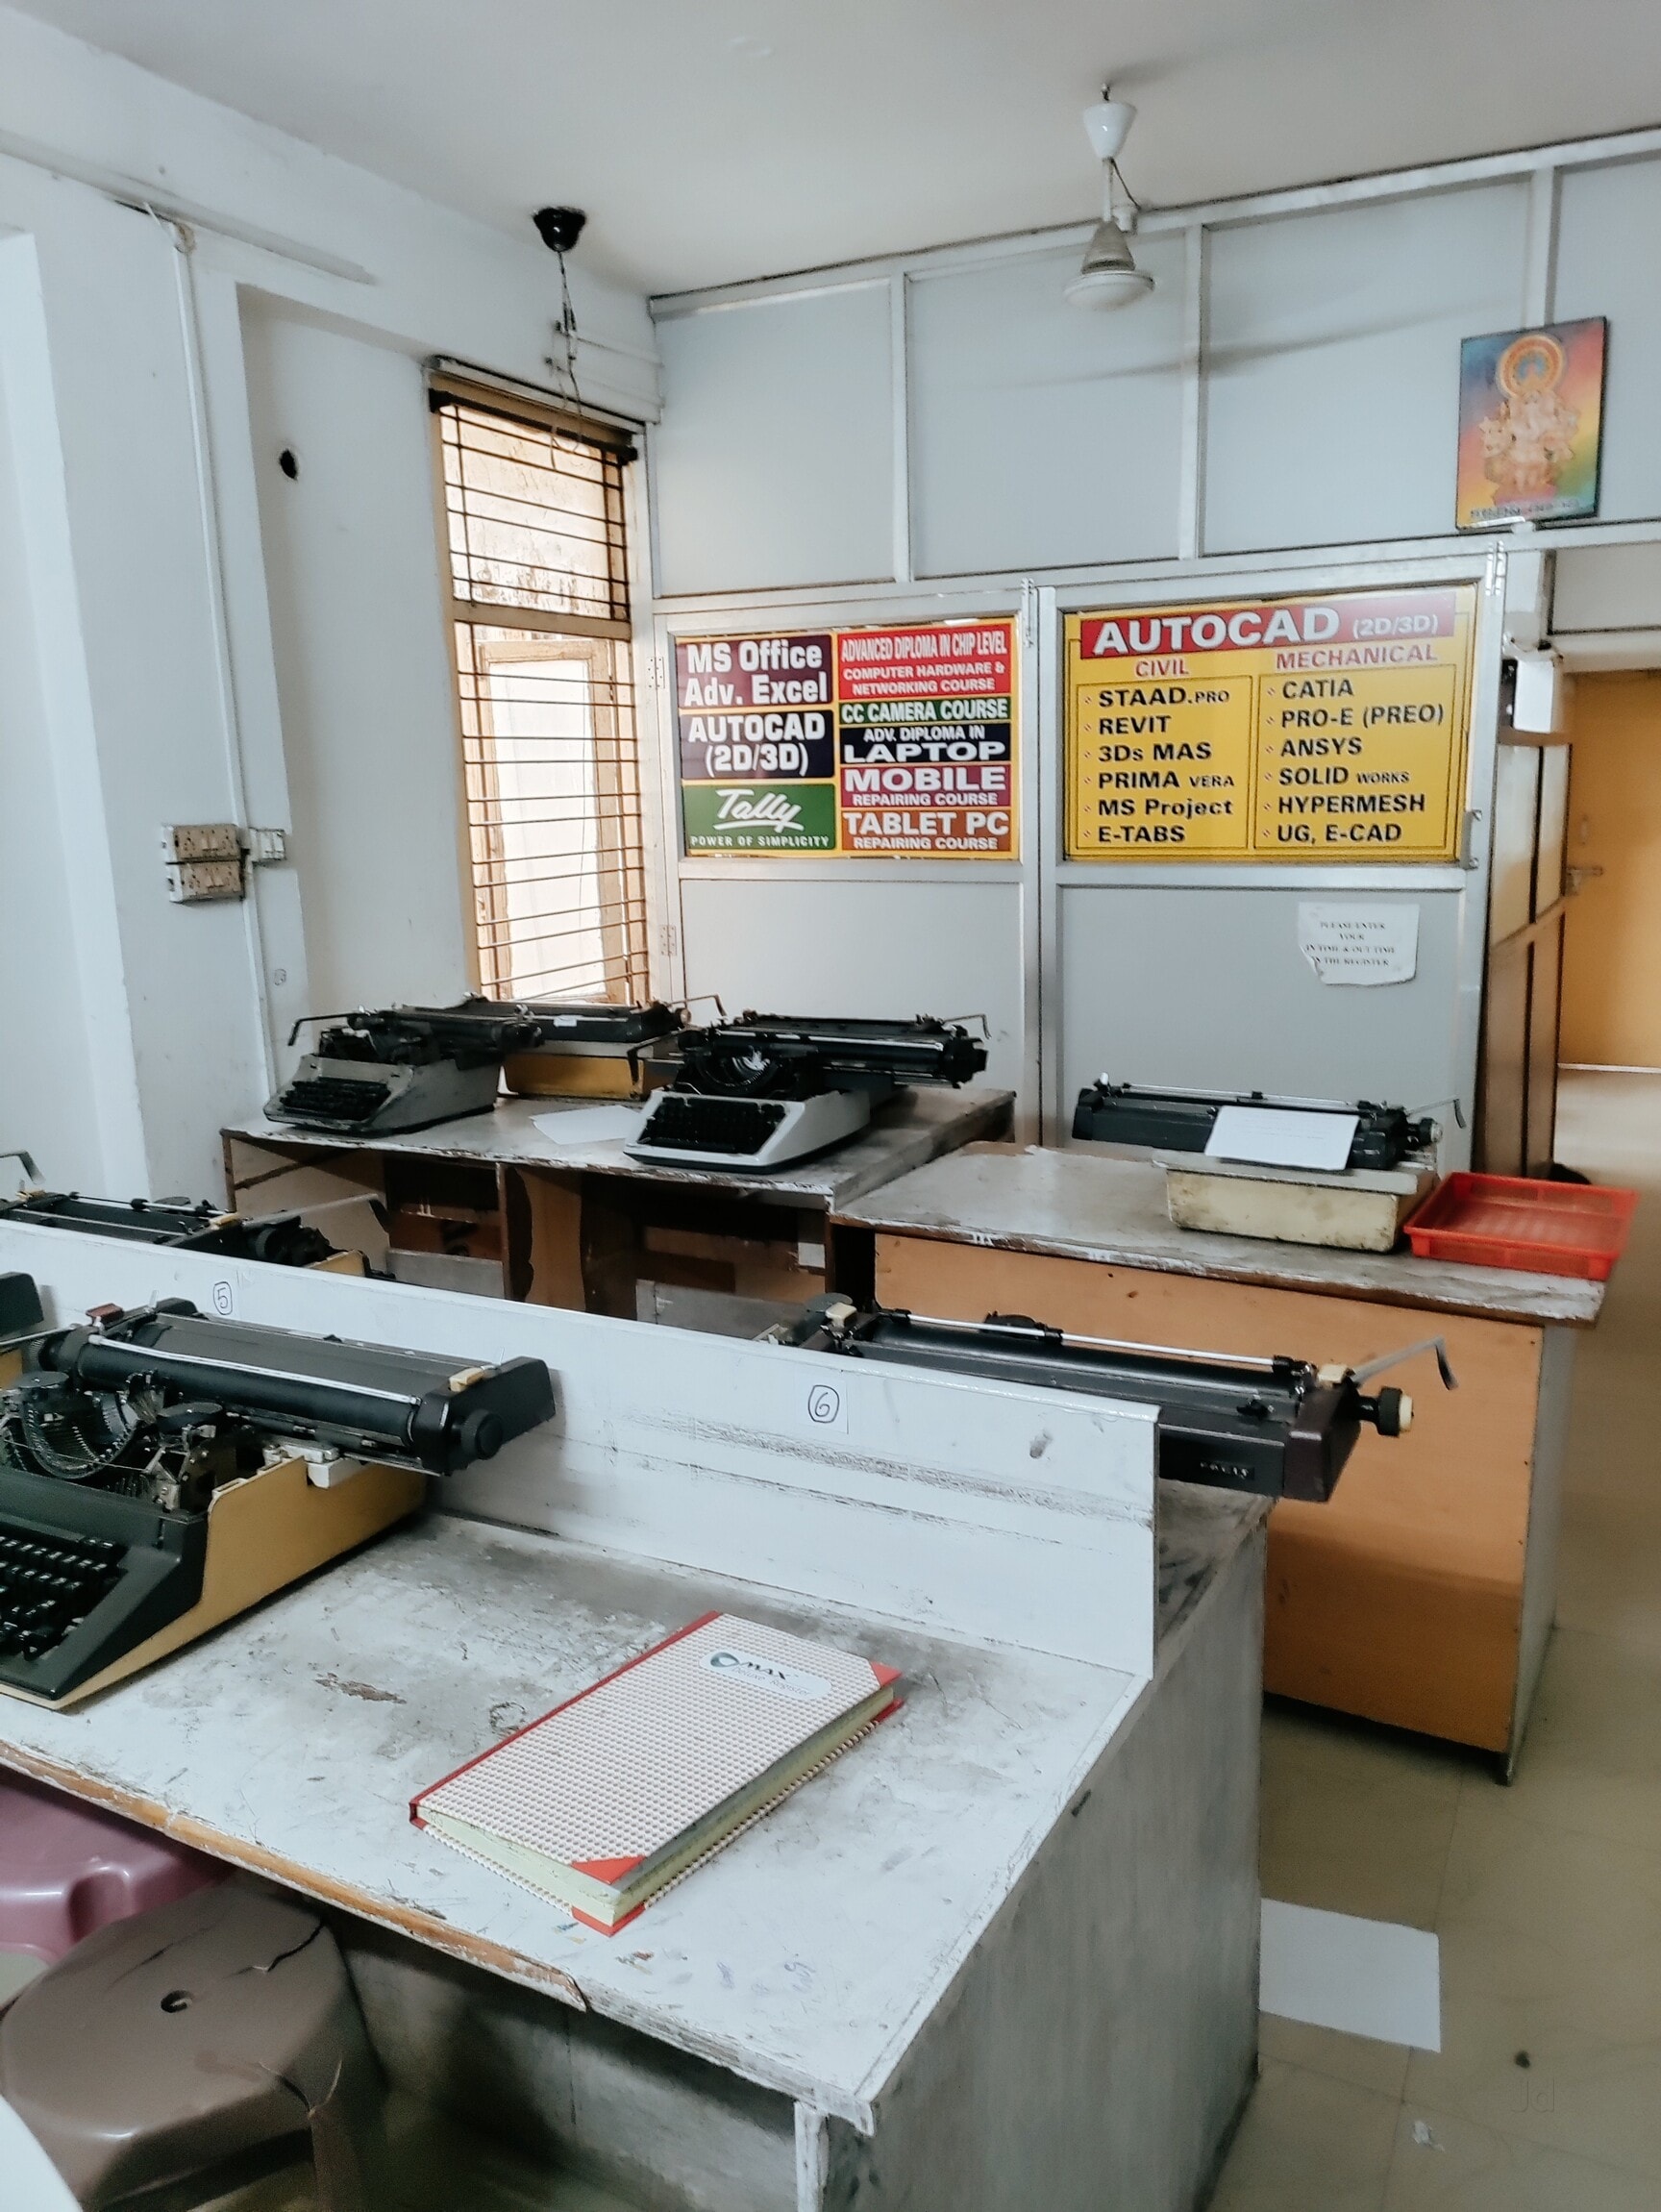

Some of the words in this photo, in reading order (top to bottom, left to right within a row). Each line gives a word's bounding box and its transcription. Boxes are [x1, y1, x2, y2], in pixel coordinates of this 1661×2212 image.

[1092, 607, 1340, 656] AUTOCAD
[1353, 614, 1438, 638] (2D/3D)
[685, 641, 732, 674] MS
[738, 638, 823, 672] Office
[841, 636, 893, 662] ADVANCED
[894, 634, 938, 659] DIPLOMA
[939, 633, 952, 658] IN
[952, 632, 976, 657] CHIP
[977, 630, 1007, 656] LEVEL
[1277, 644, 1438, 669] MECHANICAL
[843, 665, 913, 681] COMPUTER
[916, 662, 992, 678] HARDWARE
[994, 661, 1005, 674] &
[1135, 659, 1189, 678] CIVIL
[683, 676, 743, 707] Adv.
[751, 671, 828, 705] Excel
[853, 681, 938, 696] NETWORKING
[940, 678, 995, 692] COURSE
[1282, 679, 1353, 699] CATIA
[841, 704, 864, 723] CC
[867, 701, 937, 722] CAMERA
[940, 698, 1008, 720] COURSE
[1282, 708, 1353, 729] PRO-E
[1363, 704, 1443, 729] (PREO)
[688, 712, 826, 743] AUTOCAD
[863, 728, 896, 742] ADV.
[900, 726, 966, 741] DIPLOMA
[969, 725, 985, 739] IN
[1100, 715, 1172, 734] REVIT
[844, 741, 1005, 763] LAPTOP
[1098, 744, 1144, 762] 3Ds
[1153, 742, 1211, 760] MAS
[1280, 736, 1362, 757] ANSYS
[706, 742, 809, 778] (2D/3D)
[844, 766, 1006, 792] MOBILE
[1099, 771, 1179, 789] PRIMA
[1189, 776, 1234, 787] VERA
[1278, 766, 1349, 785] SOLID
[1357, 771, 1410, 784] WORKS
[853, 793, 930, 807] REPAIRING
[934, 792, 998, 806] COURSE
[1099, 799, 1135, 816] MS
[1145, 798, 1233, 820] Project
[1278, 794, 1425, 814] HYPERMESH
[715, 788, 804, 833] Tally
[843, 811, 956, 835] TABLET
[966, 811, 1009, 835] PC
[690, 835, 733, 847] POWER
[737, 835, 754, 847] OF
[757, 835, 830, 847] SIMPLICITY
[854, 836, 931, 850] REPAIRING
[935, 836, 998, 850] COURSE
[1099, 826, 1185, 843] E-TABS
[1277, 824, 1316, 844] UG,
[1326, 824, 1401, 842] E-CAD
